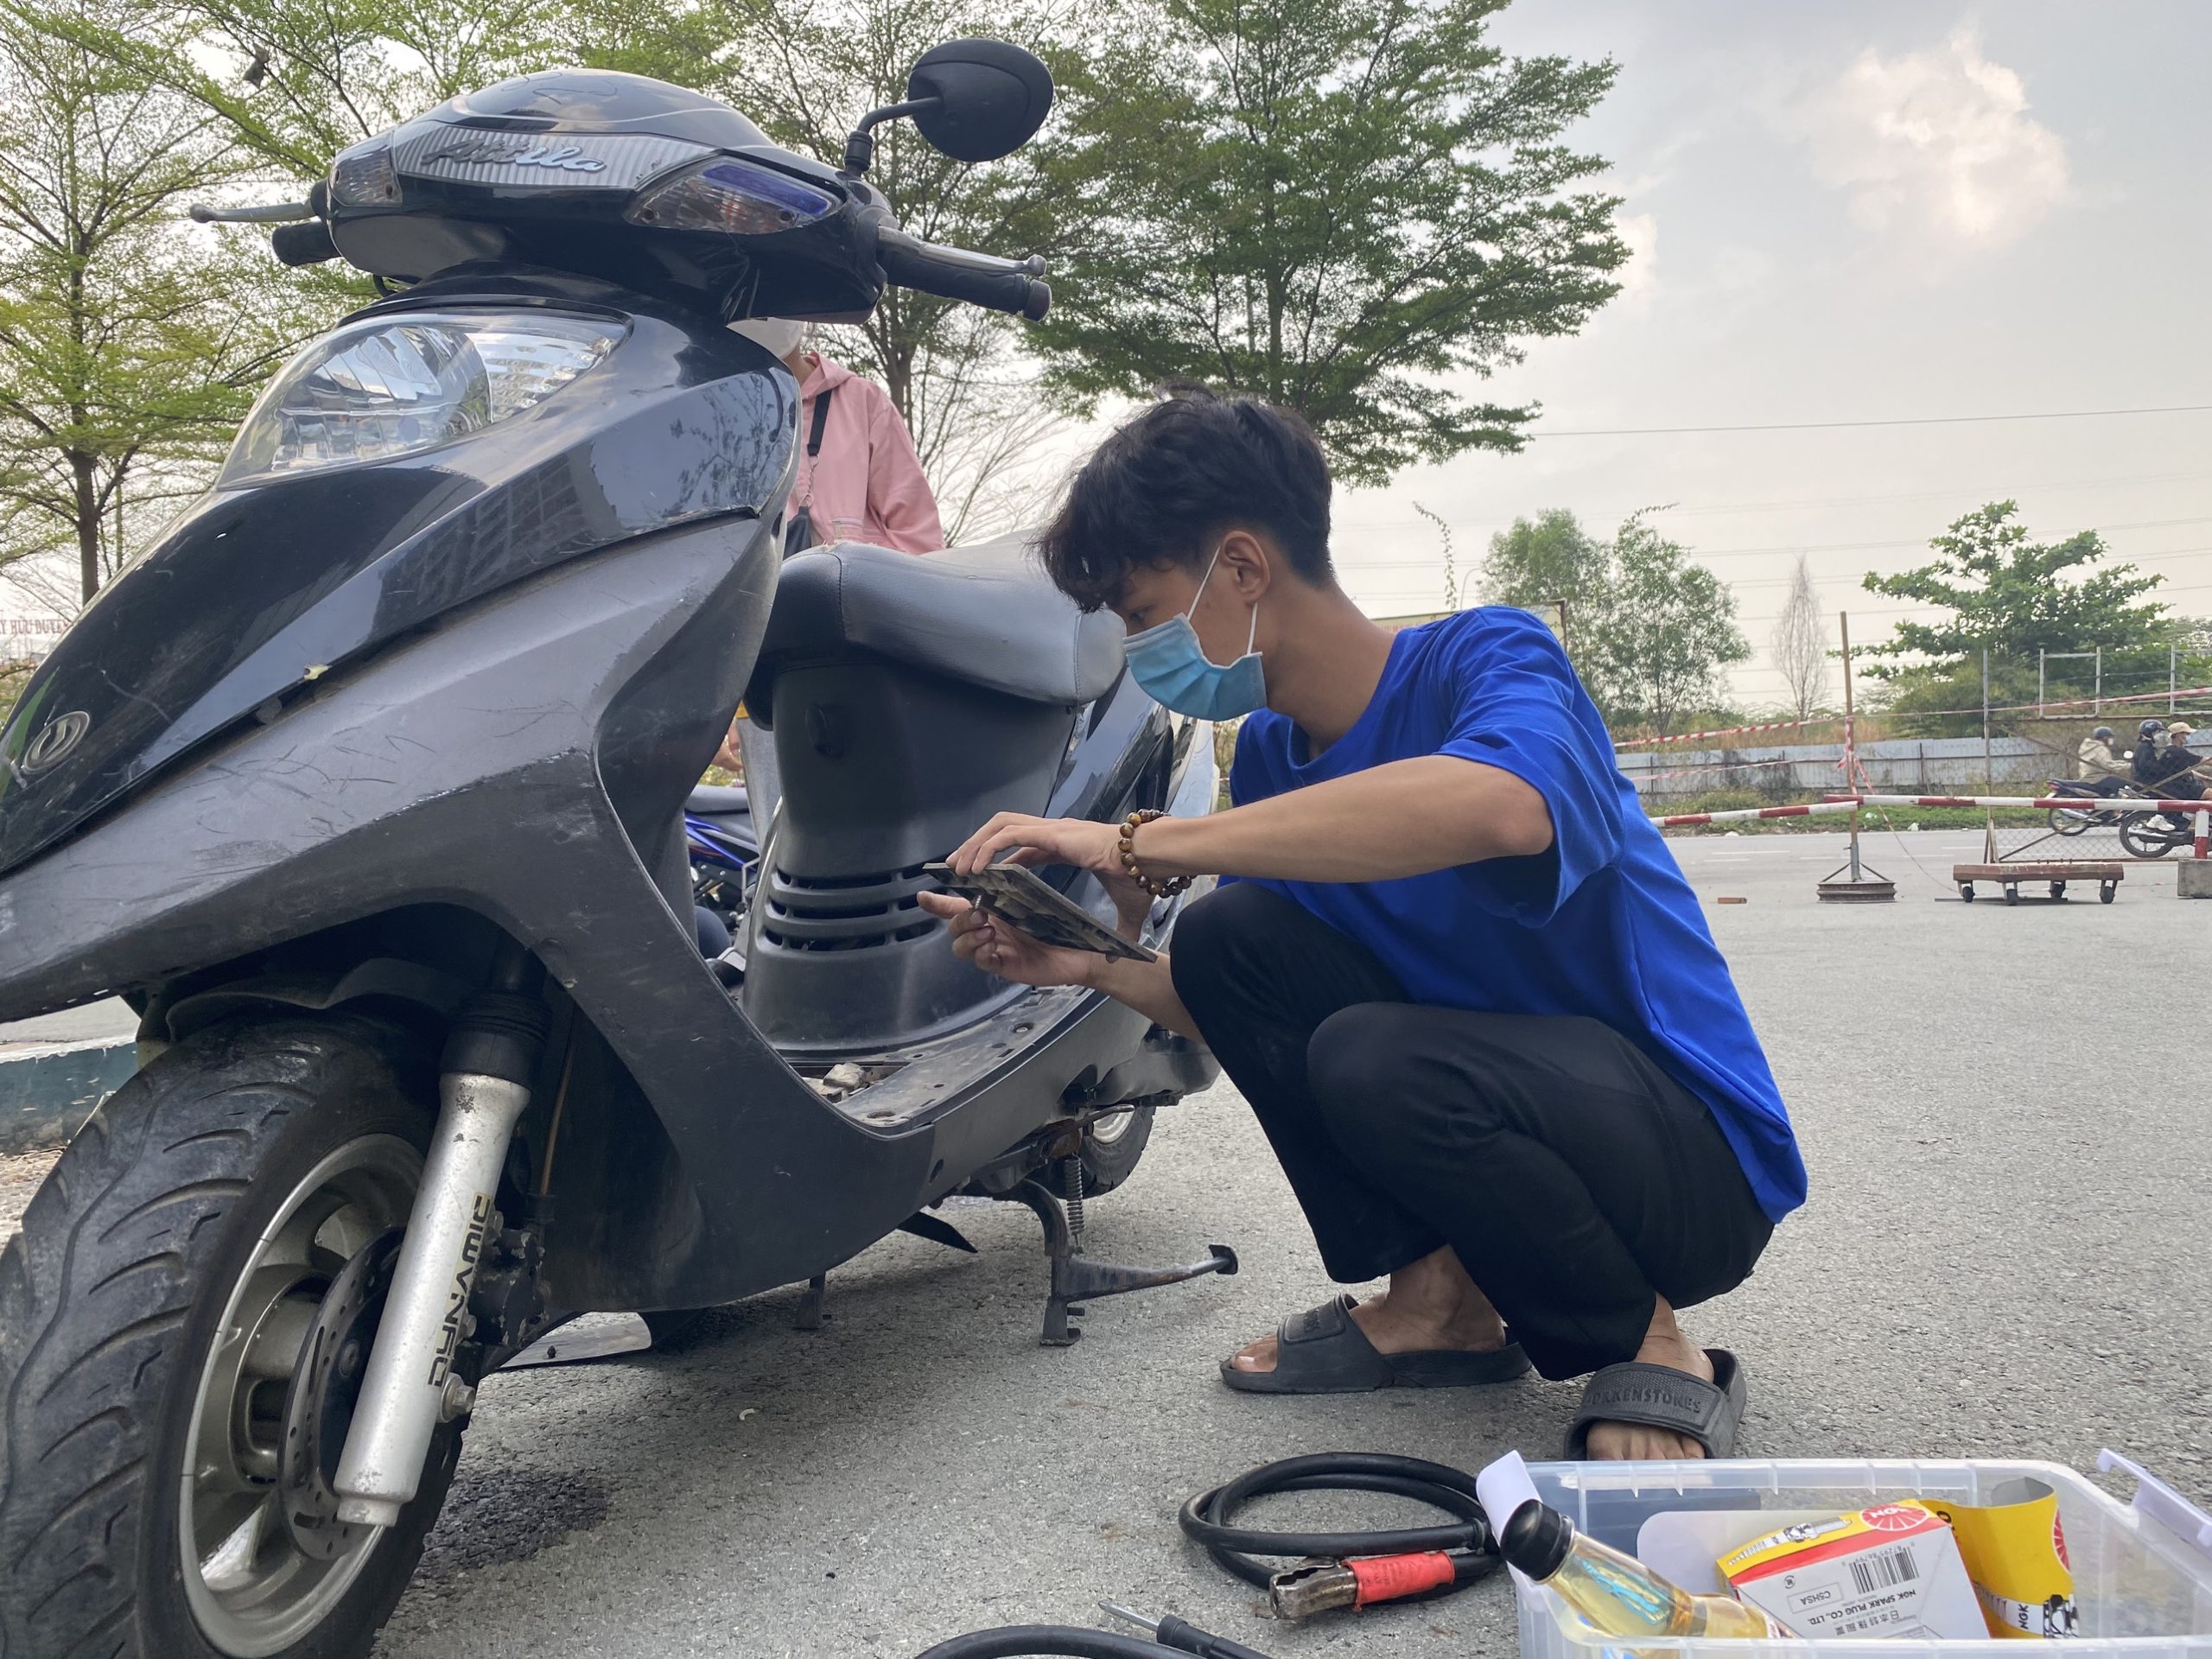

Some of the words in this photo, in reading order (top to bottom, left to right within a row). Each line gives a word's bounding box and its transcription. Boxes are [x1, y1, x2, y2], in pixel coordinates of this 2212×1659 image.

[420, 138, 607, 172] Attila
[427, 1195, 491, 1387] DYNAMIC
[1867, 1595, 1896, 1609] SPARK
[1897, 1589, 1916, 1600] NGK
[1845, 1604, 1867, 1616] PLUG
[2018, 1603, 2029, 1630] NGK
